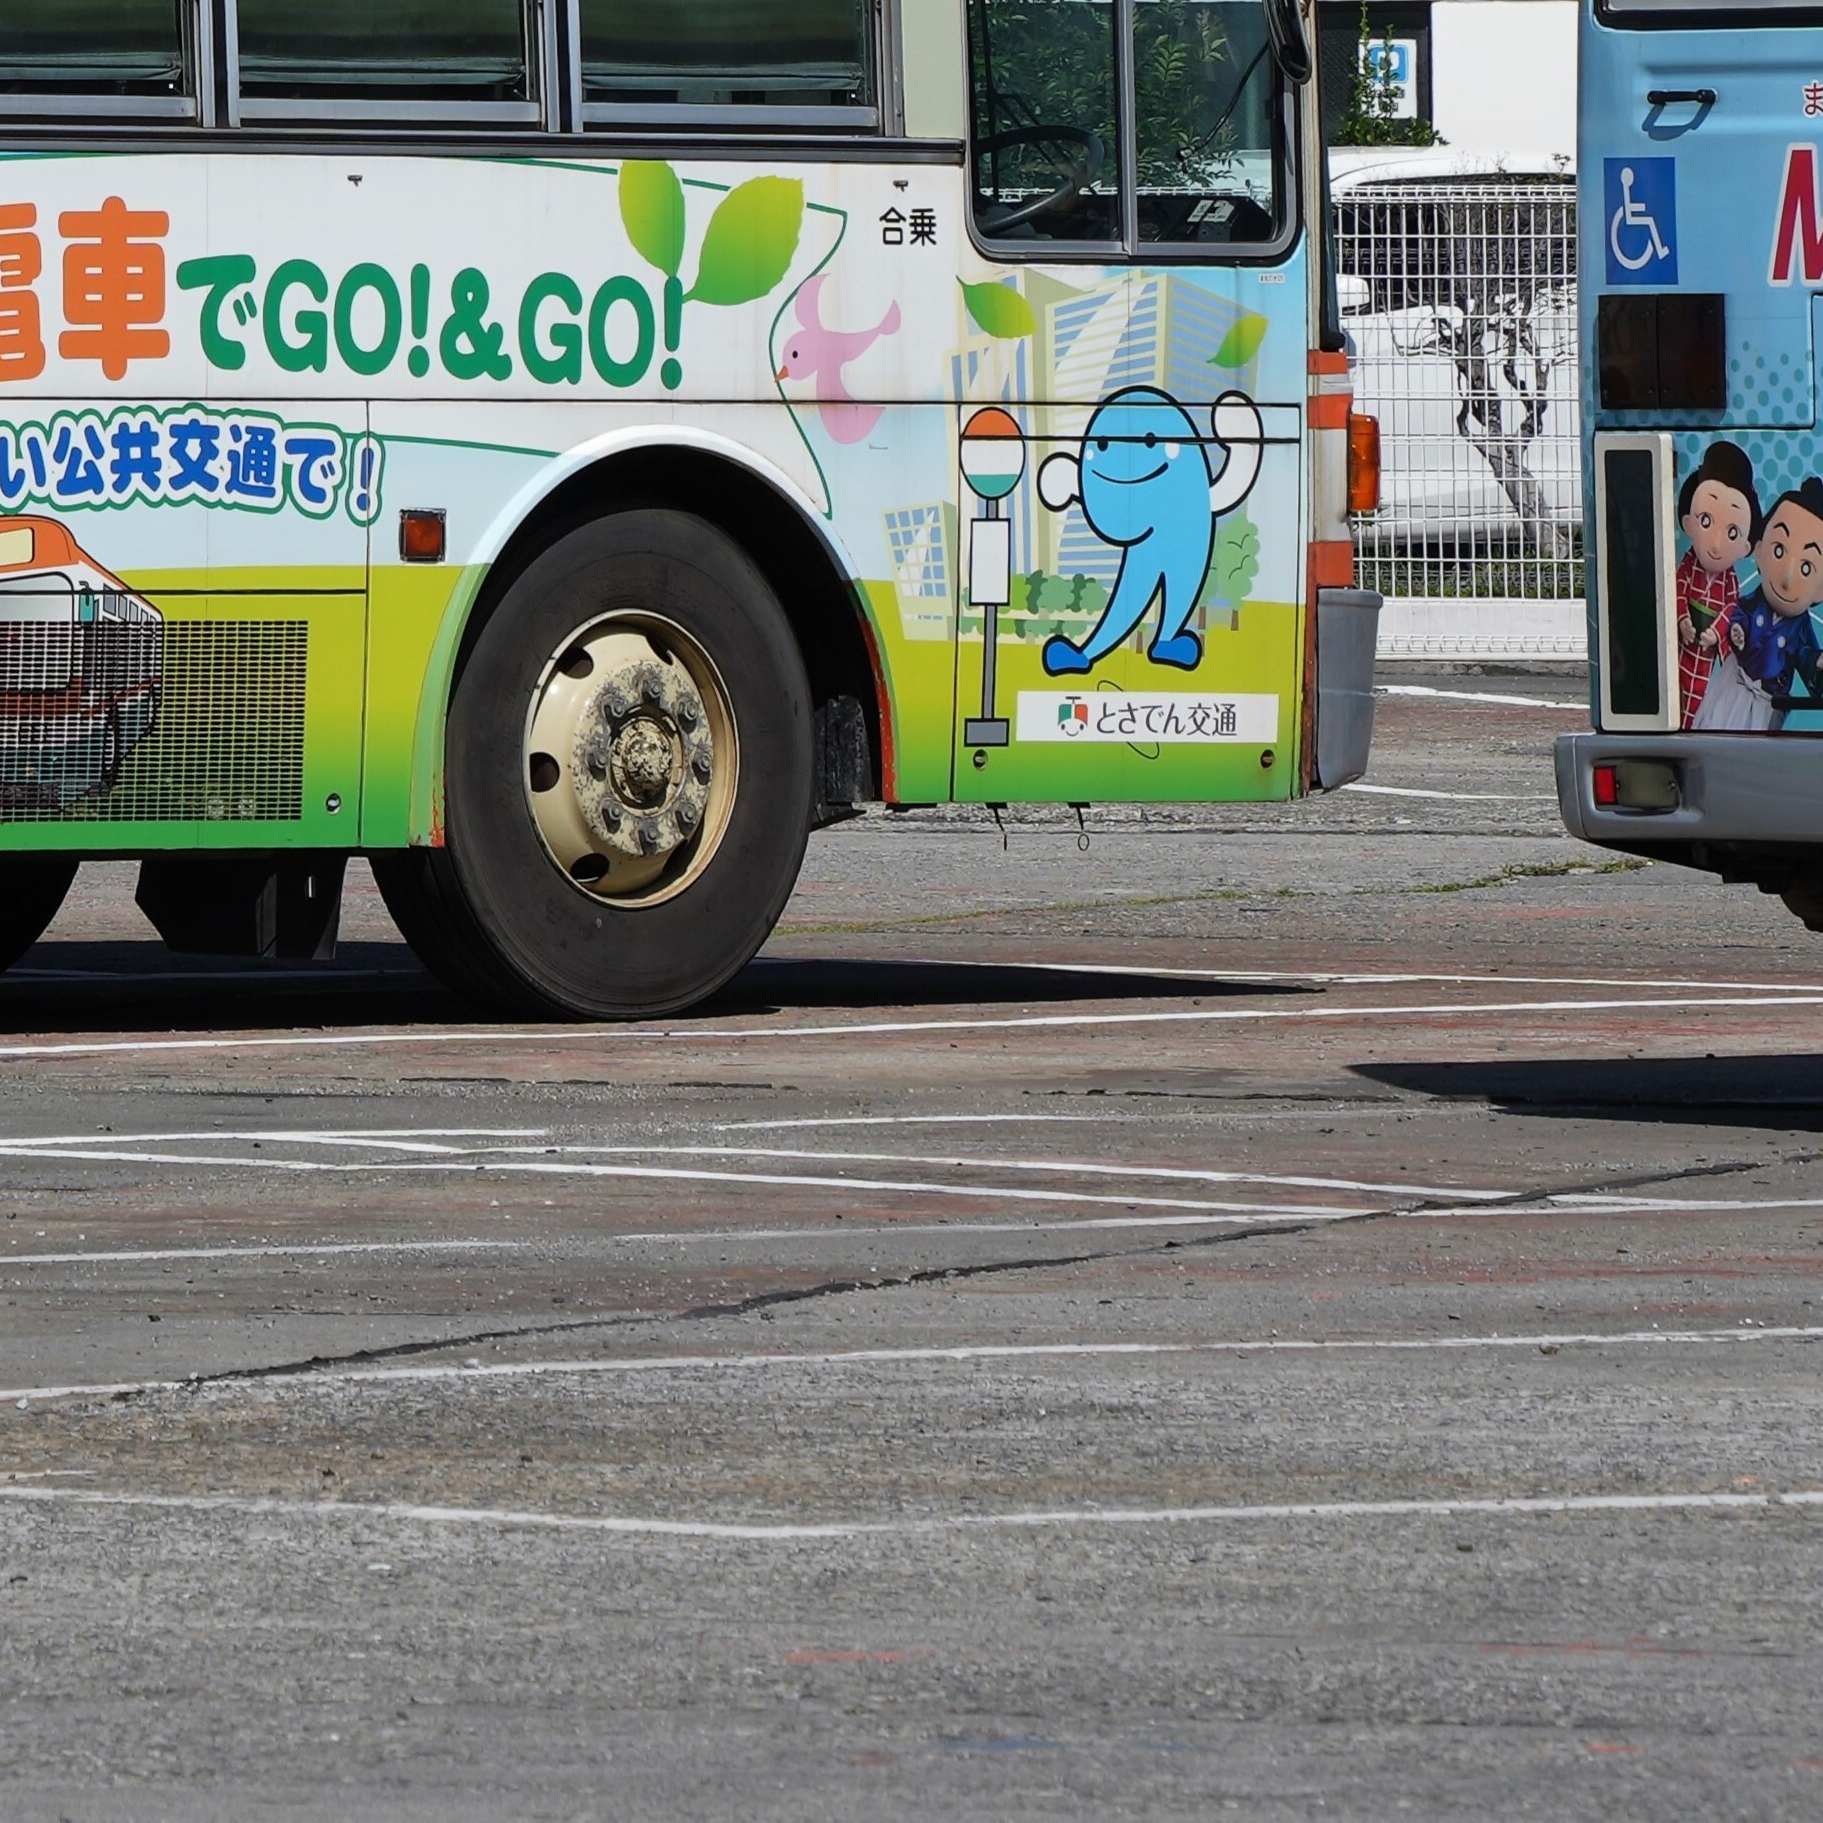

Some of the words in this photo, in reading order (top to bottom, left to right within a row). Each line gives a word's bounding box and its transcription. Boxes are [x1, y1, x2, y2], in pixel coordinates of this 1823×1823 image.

[879, 205, 938, 248] 合乗
[1095, 699, 1239, 738] とさでん交通
